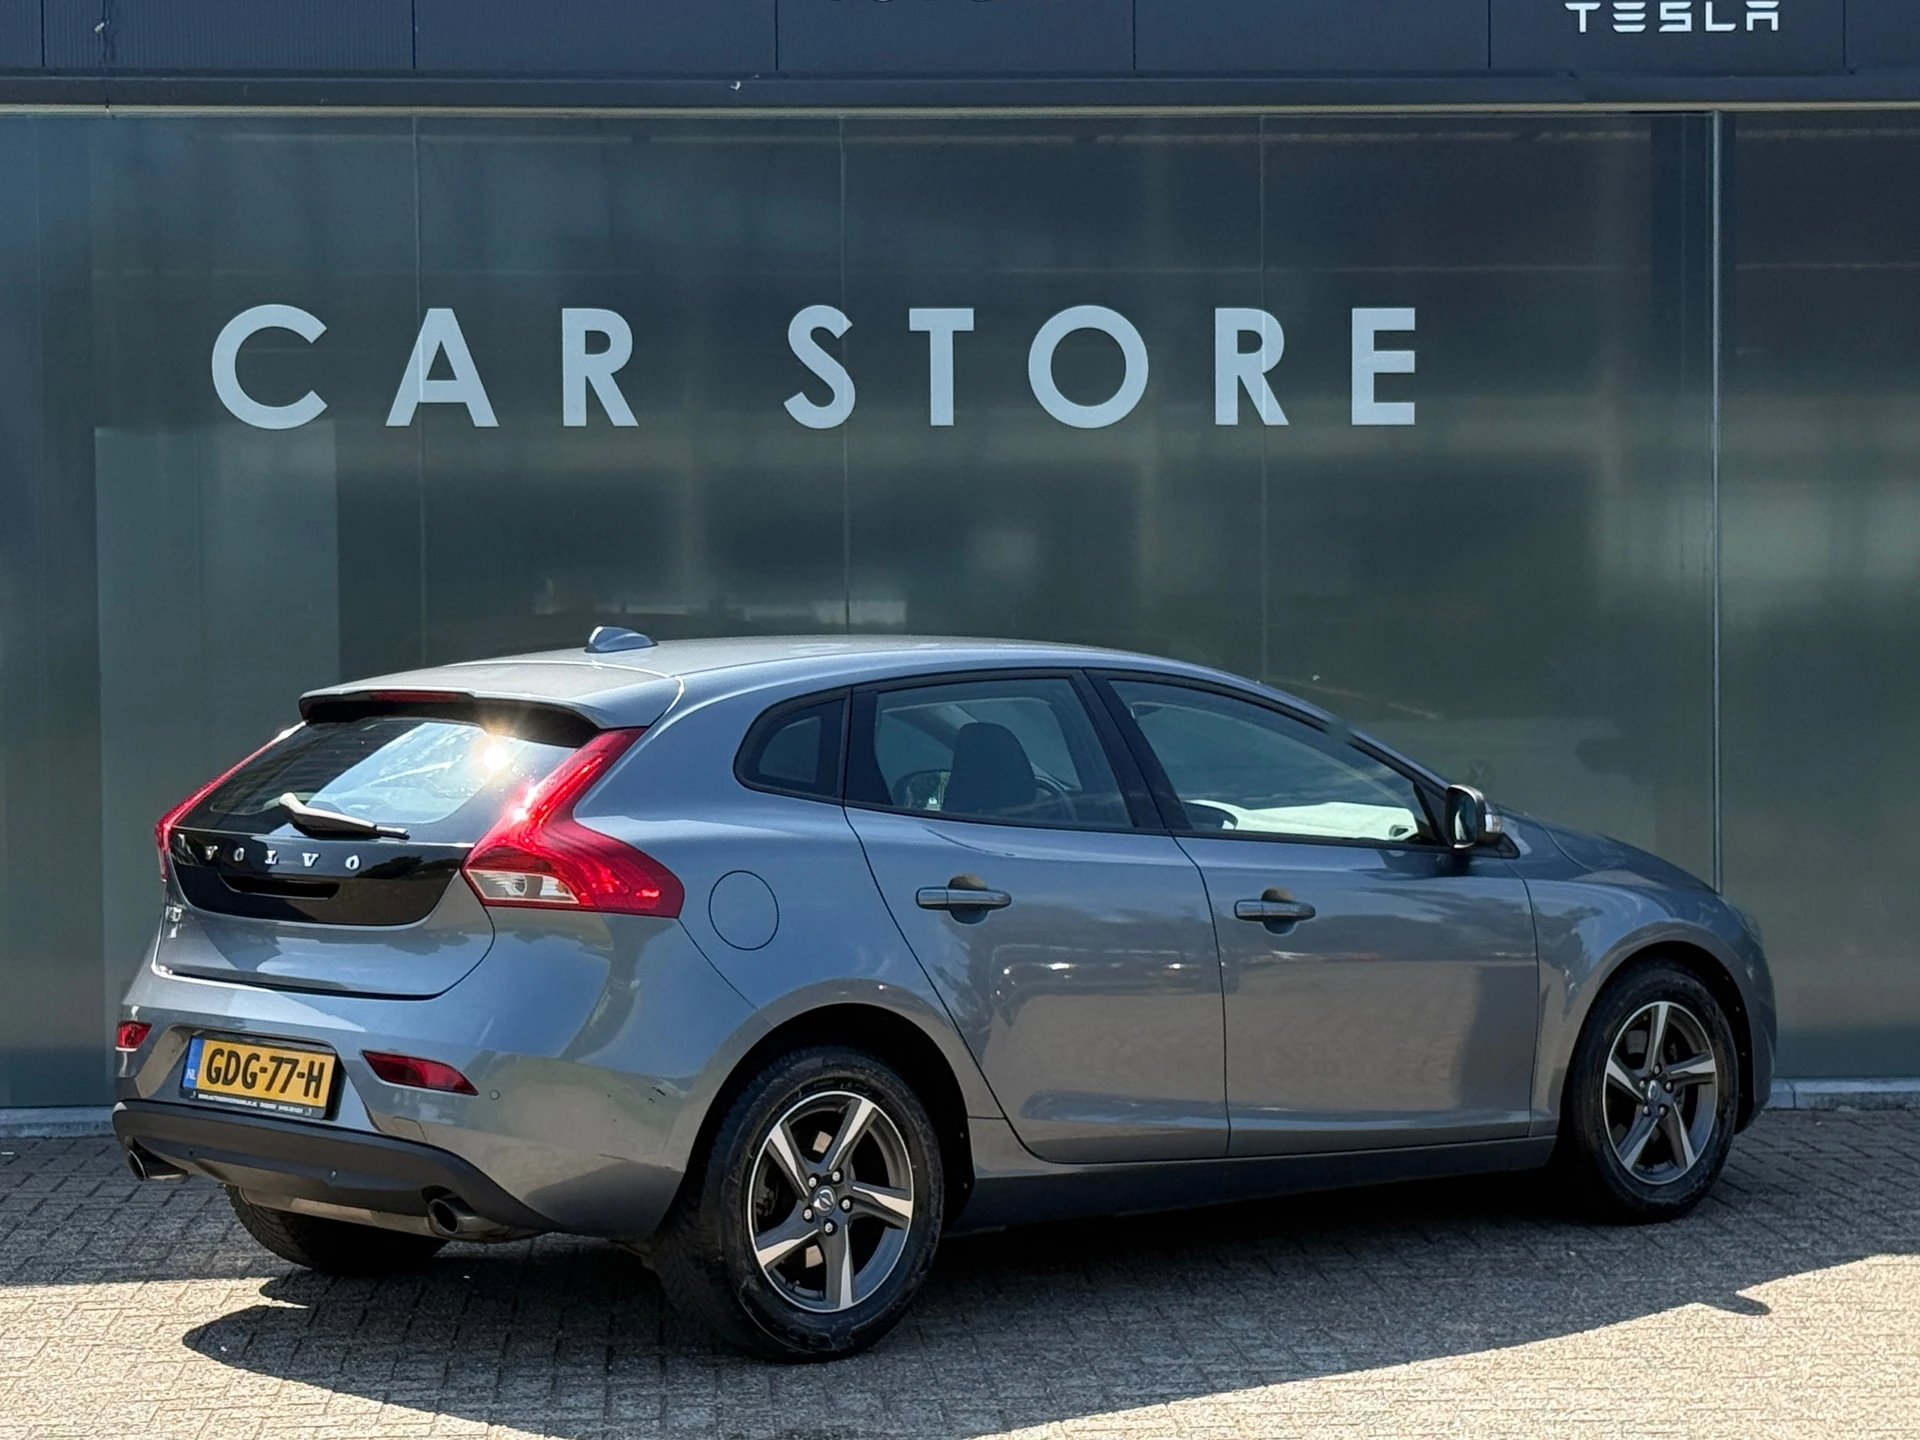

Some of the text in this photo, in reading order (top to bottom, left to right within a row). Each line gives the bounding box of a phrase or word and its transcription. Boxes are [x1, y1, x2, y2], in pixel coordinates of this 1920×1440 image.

[1565, 1, 1779, 33] TESLA
[212, 304, 1416, 430] CAR STORE
[205, 845, 361, 870] VOLVO
[186, 1068, 197, 1081] NL
[205, 1048, 325, 1099] GDG-77-H
